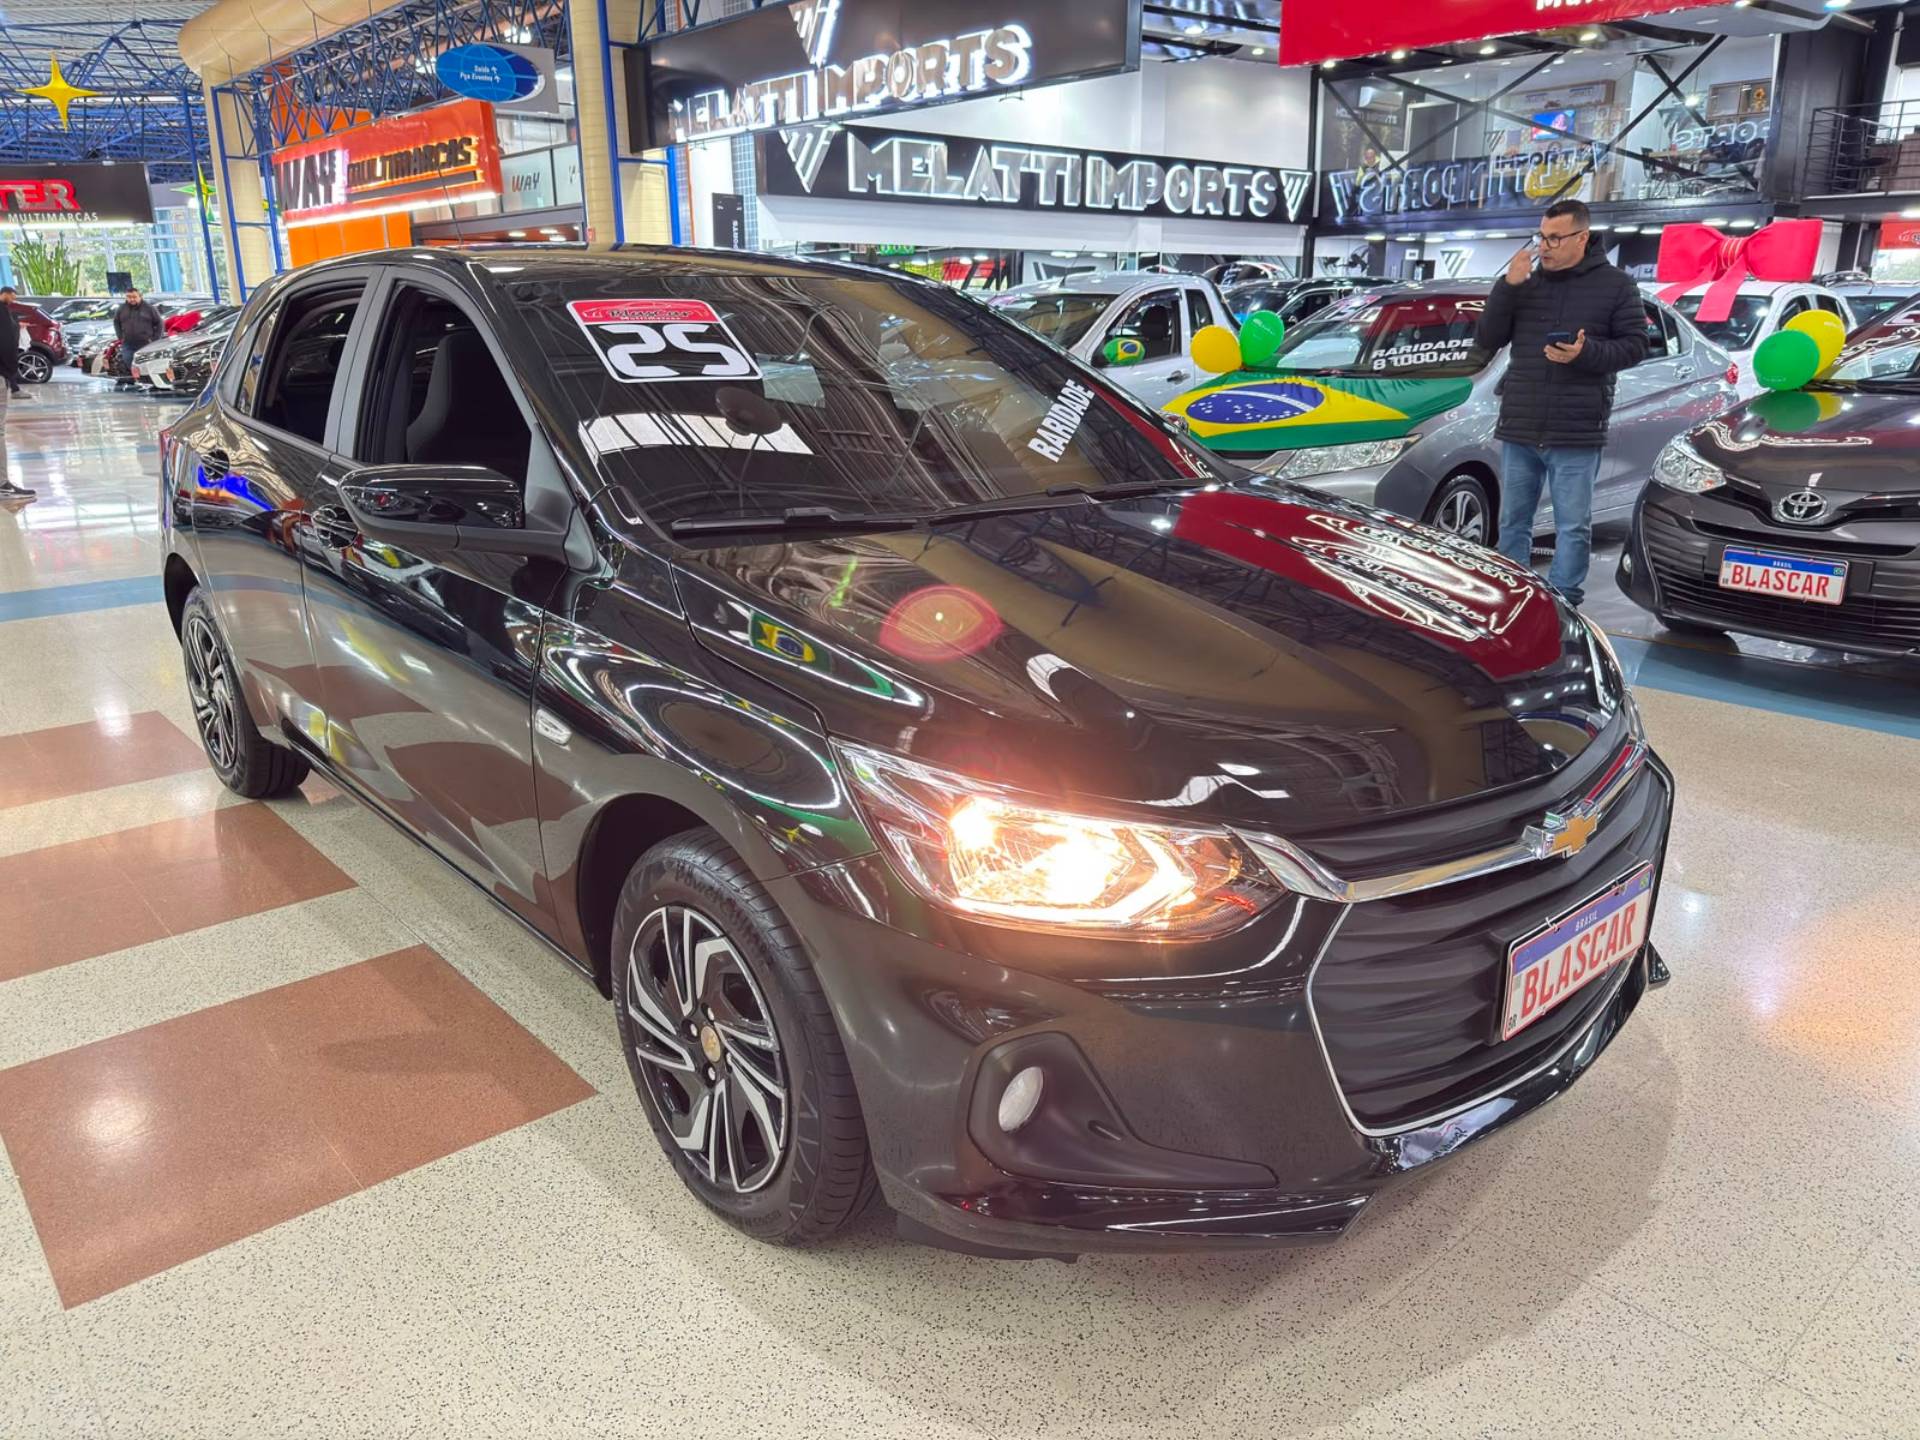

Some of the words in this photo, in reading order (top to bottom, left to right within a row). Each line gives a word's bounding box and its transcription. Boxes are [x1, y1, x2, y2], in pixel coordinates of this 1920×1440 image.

[816, 24, 1032, 117] IMPORTS
[275, 149, 341, 212] WAY
[347, 136, 475, 188] MULTIMARCAS
[512, 172, 540, 192] WAY
[847, 132, 1081, 206] MELATTI
[1086, 155, 1278, 217] IMPORTS
[8, 212, 98, 223] MULTIMARCAS
[598, 324, 750, 378] 25
[1371, 338, 1474, 359] RARIDADE
[1027, 379, 1095, 463] RARIDADE
[1731, 565, 1829, 597] BLASCAR
[1575, 910, 1598, 931] BRASIL
[1521, 902, 1637, 1019] BLASCAR
